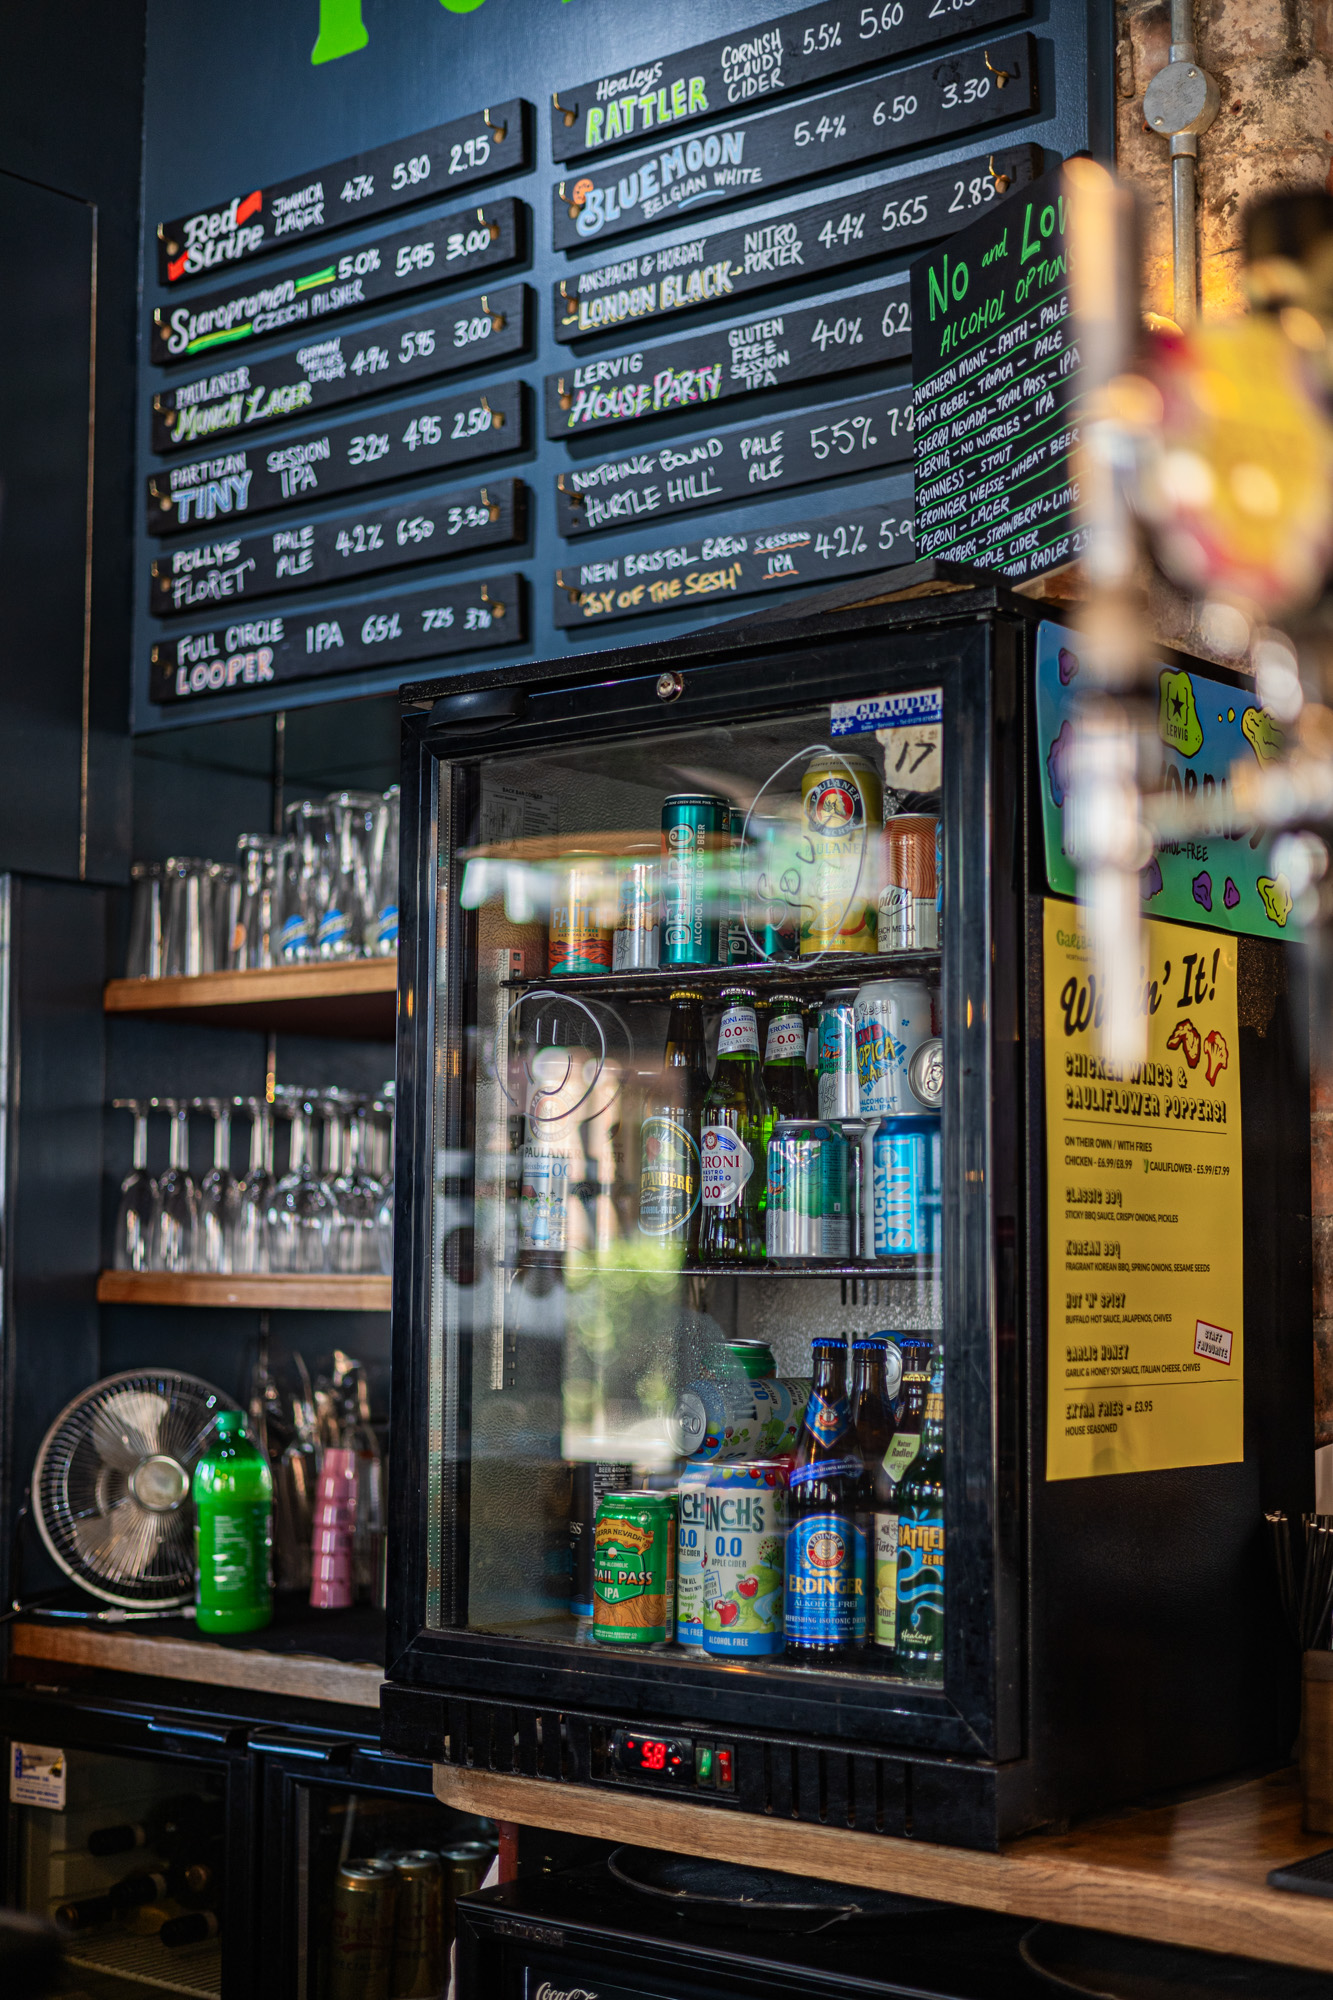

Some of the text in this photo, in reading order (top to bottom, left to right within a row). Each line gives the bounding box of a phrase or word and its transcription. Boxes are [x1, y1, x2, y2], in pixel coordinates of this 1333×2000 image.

[802, 22, 842, 56] 5.5%
[859, 1, 904, 40] 5.60
[721, 28, 782, 69] CORNISH
[596, 62, 663, 102] Healeys
[723, 49, 784, 85] CLOUDY
[728, 67, 785, 104] CIDER
[584, 76, 709, 149] RATTLER
[793, 77, 990, 146] 5.4% 6.50 3.30
[391, 135, 490, 190] 5.80 2.95
[641, 167, 763, 219] BELGIAN WHITE
[183, 198, 240, 248] Red
[275, 202, 324, 236] LAGER
[817, 175, 996, 250] 4.4% 5.65 2.85
[183, 224, 264, 273] Stripe
[338, 229, 490, 279] 5.0% 5.95 3.00
[744, 222, 797, 253] NITRO
[578, 239, 706, 293] ANSPACH & HOBDAY
[743, 241, 804, 274] PORTER
[252, 278, 365, 333] CZECH PILSNER
[578, 260, 734, 329] LONDON BLACK
[168, 280, 297, 354] Staropramen
[453, 318, 492, 346] 3.00
[728, 318, 784, 348] GLUTEN
[940, 290, 1005, 356] ALCOHOL
[811, 317, 863, 352] 4.0%
[959, 297, 1068, 378] MONK FAITH PALE
[731, 341, 777, 363] FREE
[731, 351, 790, 379] SESSION
[573, 353, 643, 388] LERVIG
[745, 373, 778, 391] IPA
[940, 331, 1062, 418] REBEL TROPICA PALE
[176, 366, 250, 409] PAULANER
[570, 365, 722, 426] HOUSE PARTY
[402, 407, 492, 452] 4.95 2.50
[919, 374, 1046, 457] SIERRA NEVADA TRAIL PASS
[740, 431, 784, 459] PALE
[810, 416, 878, 459] 5.5%
[919, 391, 1055, 479] LERVIG NO WORRIES IPA
[169, 452, 247, 490] PARTIZAN
[267, 437, 331, 473] SESSION
[571, 438, 723, 491] NOTHING BOUND
[749, 456, 784, 484] ALE
[981, 444, 1013, 473] STOUT
[280, 465, 318, 498] IPA
[921, 428, 1080, 529] ERDINGER BEER
[171, 470, 253, 524] TINY
[447, 506, 489, 536] 3.30
[921, 496, 1010, 553] PERONI LAGER
[273, 525, 315, 553] PALE
[754, 531, 810, 551] SESSION
[1010, 530, 1039, 556] CIDER
[1031, 539, 1069, 571] RADLER
[172, 538, 242, 574] POLLYS
[276, 549, 314, 578] ALE
[581, 538, 748, 585] NEW BRISTOL BREW
[768, 555, 794, 575] IPA
[617, 575, 681, 608] OF THE
[177, 618, 284, 666] FULL CIRCLE
[306, 621, 344, 654] IPA
[175, 646, 274, 697] LOOPER
[1166, 724, 1188, 742] LERVIG
[895, 741, 936, 774] 17
[810, 779, 860, 802] PAULANER
[697, 824, 705, 845] BEER
[694, 902, 703, 945] ALCOHOL
[892, 924, 916, 932] MELBA
[1177, 948, 1221, 1008] It!
[859, 1000, 892, 1016] Rebel
[1064, 1083, 1226, 1124] CAULIFLOWER POPPERS!
[1076, 1137, 1152, 1152] THEIR OWN WITH FRIES
[1065, 1155, 1132, 1170] CHICKEN £6.99/£8.99
[1150, 1161, 1230, 1176] CAULIFLOWER £5.99/£7.99
[875, 1167, 887, 1249] LUCKY
[887, 1167, 911, 1248] SAINT
[1158, 1215, 1178, 1223] PICKLES
[1066, 1262, 1210, 1272] FRAGRANT KOREAN SESAME SEEDS
[1066, 1313, 1172, 1324] BUFFALO CHIVES
[1066, 1344, 1129, 1362] GARLIC HONEY
[1066, 1363, 1200, 1377] GARLIC HONEY ITALIAN CHIVES
[1066, 1400, 1153, 1421] EXTRA FRIES £3.95
[1065, 1423, 1117, 1436] HOUSE SEASONED
[891, 1446, 914, 1458] Radler
[613, 1527, 644, 1543] NEVADA
[715, 1536, 742, 1558] 0.0
[808, 1533, 843, 1550] ERDINGER
[687, 1550, 700, 1558] CIDER
[712, 1558, 746, 1568] APPLE CIDER
[604, 1587, 619, 1599] IPA
[618, 1571, 652, 1585] PASS
[789, 1574, 864, 1596] ERDINGER
[690, 1626, 703, 1636] FREE
[819, 1615, 850, 1624] ISOTONIC
[709, 1636, 749, 1647] ALCOHOL FREE
